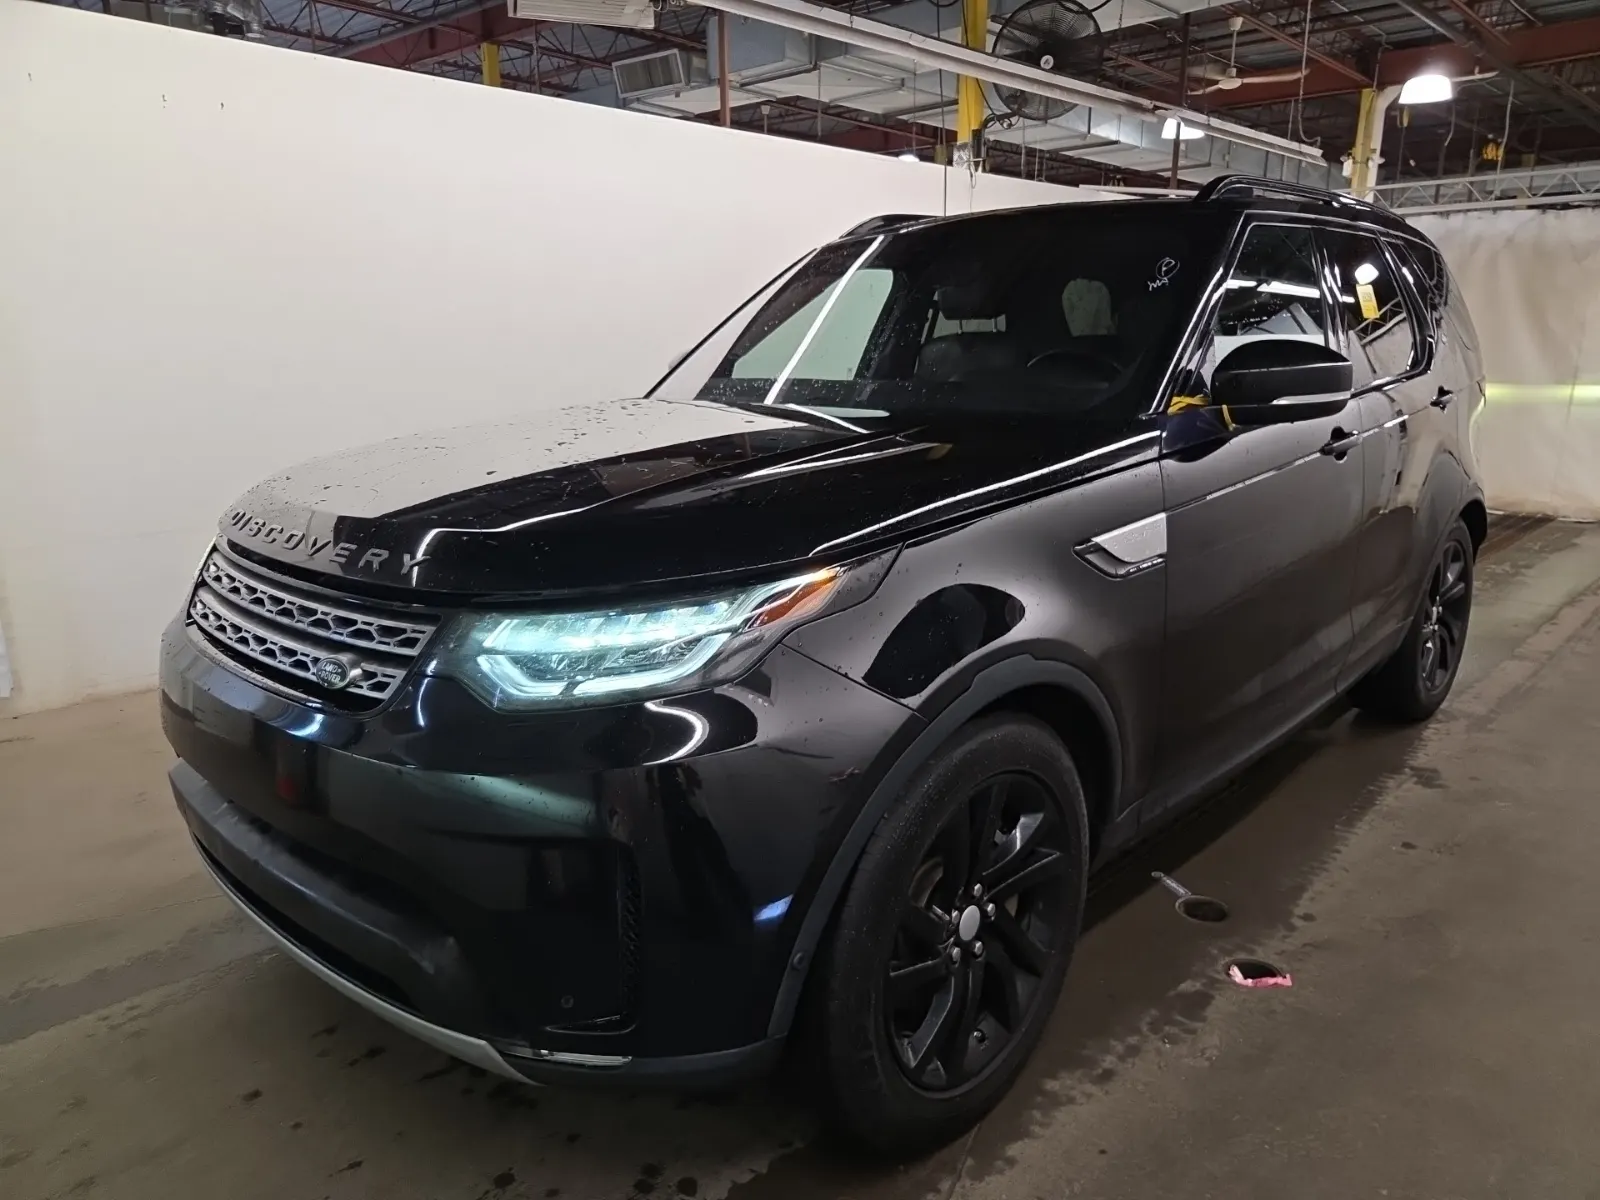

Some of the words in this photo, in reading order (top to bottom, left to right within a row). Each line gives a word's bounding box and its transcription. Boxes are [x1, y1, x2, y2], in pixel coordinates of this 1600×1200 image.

[231, 508, 431, 575] DISCOVERY
[321, 661, 339, 673] LAND
[320, 670, 341, 684] ROVER
